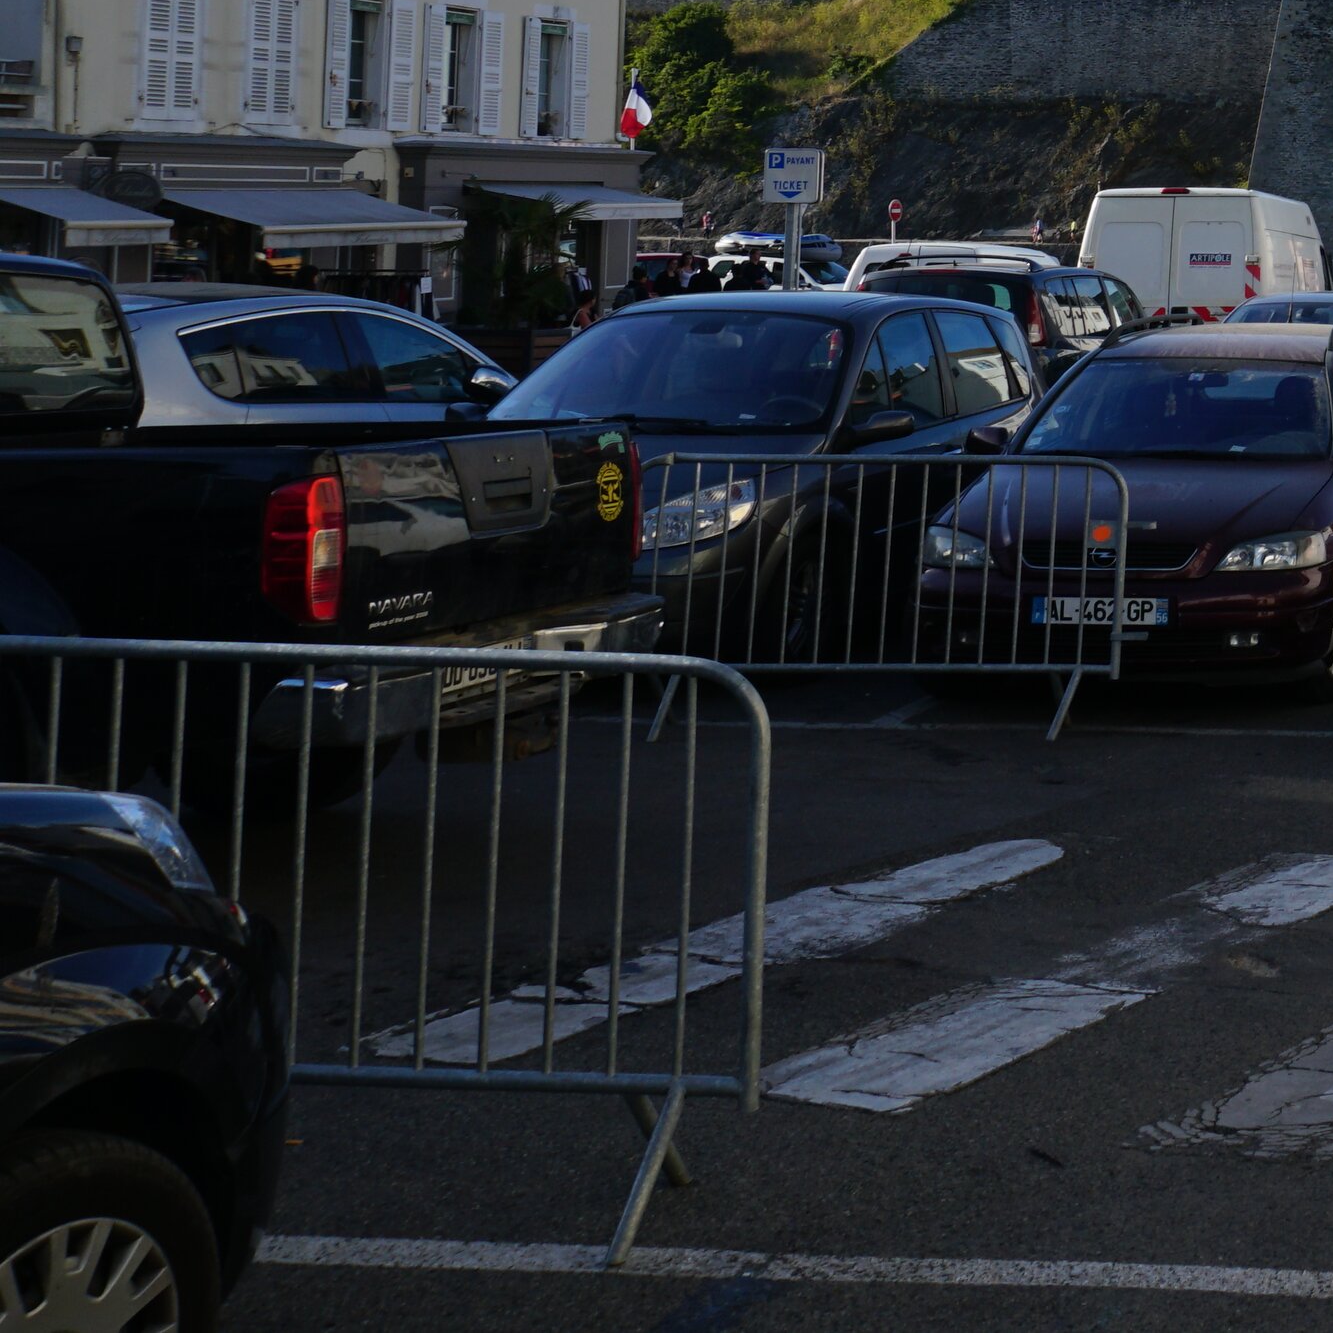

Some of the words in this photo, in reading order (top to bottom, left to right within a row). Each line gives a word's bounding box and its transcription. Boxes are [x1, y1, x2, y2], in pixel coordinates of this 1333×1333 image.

[772, 154, 781, 167] P
[786, 156, 815, 165] PAYANT
[773, 180, 808, 190] TICKET
[369, 591, 432, 614] NAVARA
[1156, 613, 1168, 623] 56
